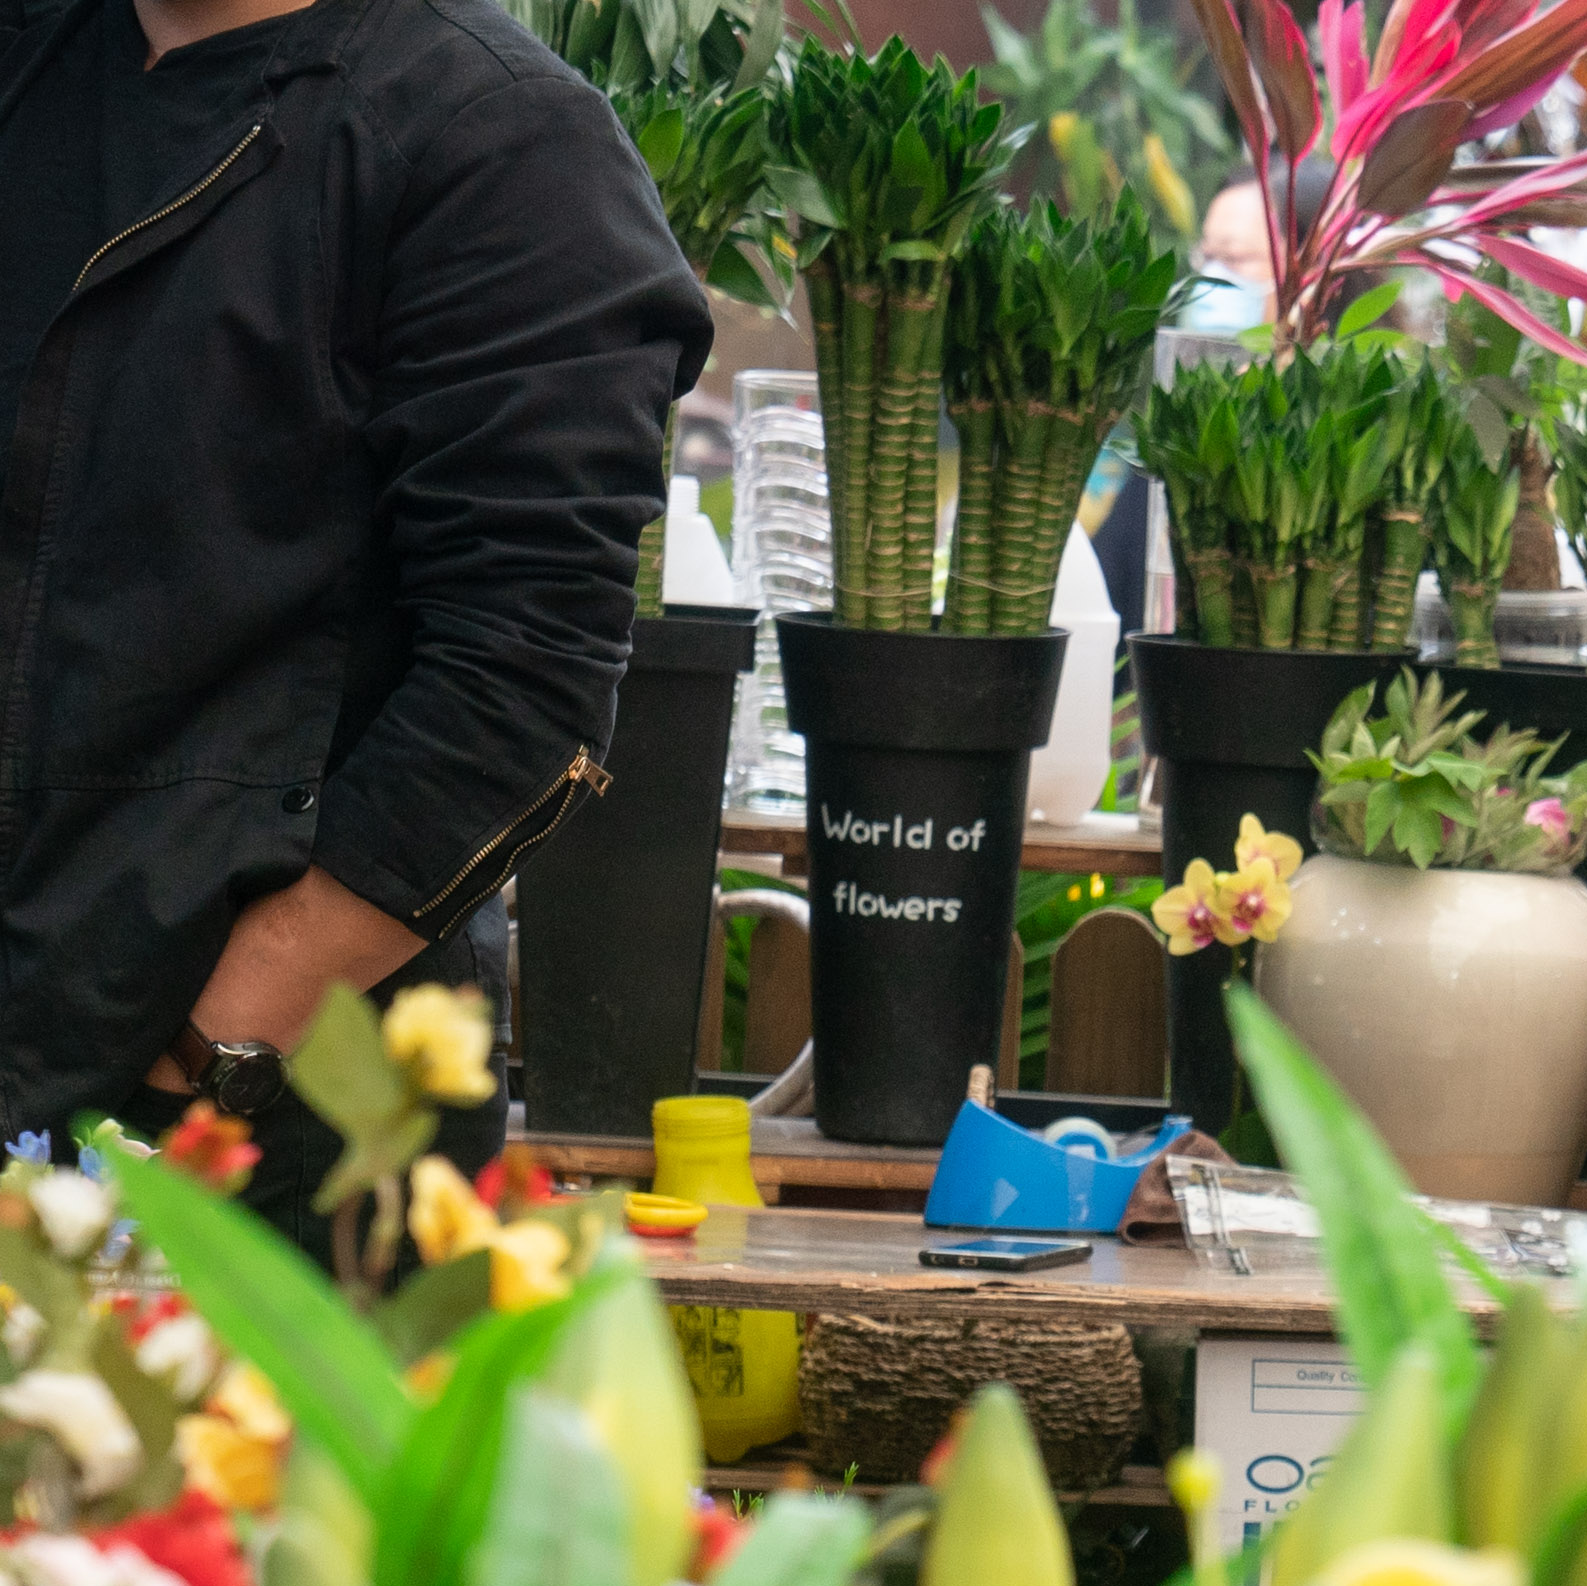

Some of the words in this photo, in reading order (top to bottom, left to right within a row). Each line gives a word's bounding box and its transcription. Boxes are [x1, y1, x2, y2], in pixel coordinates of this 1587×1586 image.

[821, 803, 933, 850] World
[946, 819, 987, 851] of
[833, 881, 963, 922] flowers
[1296, 1369, 1334, 1383] Quality
